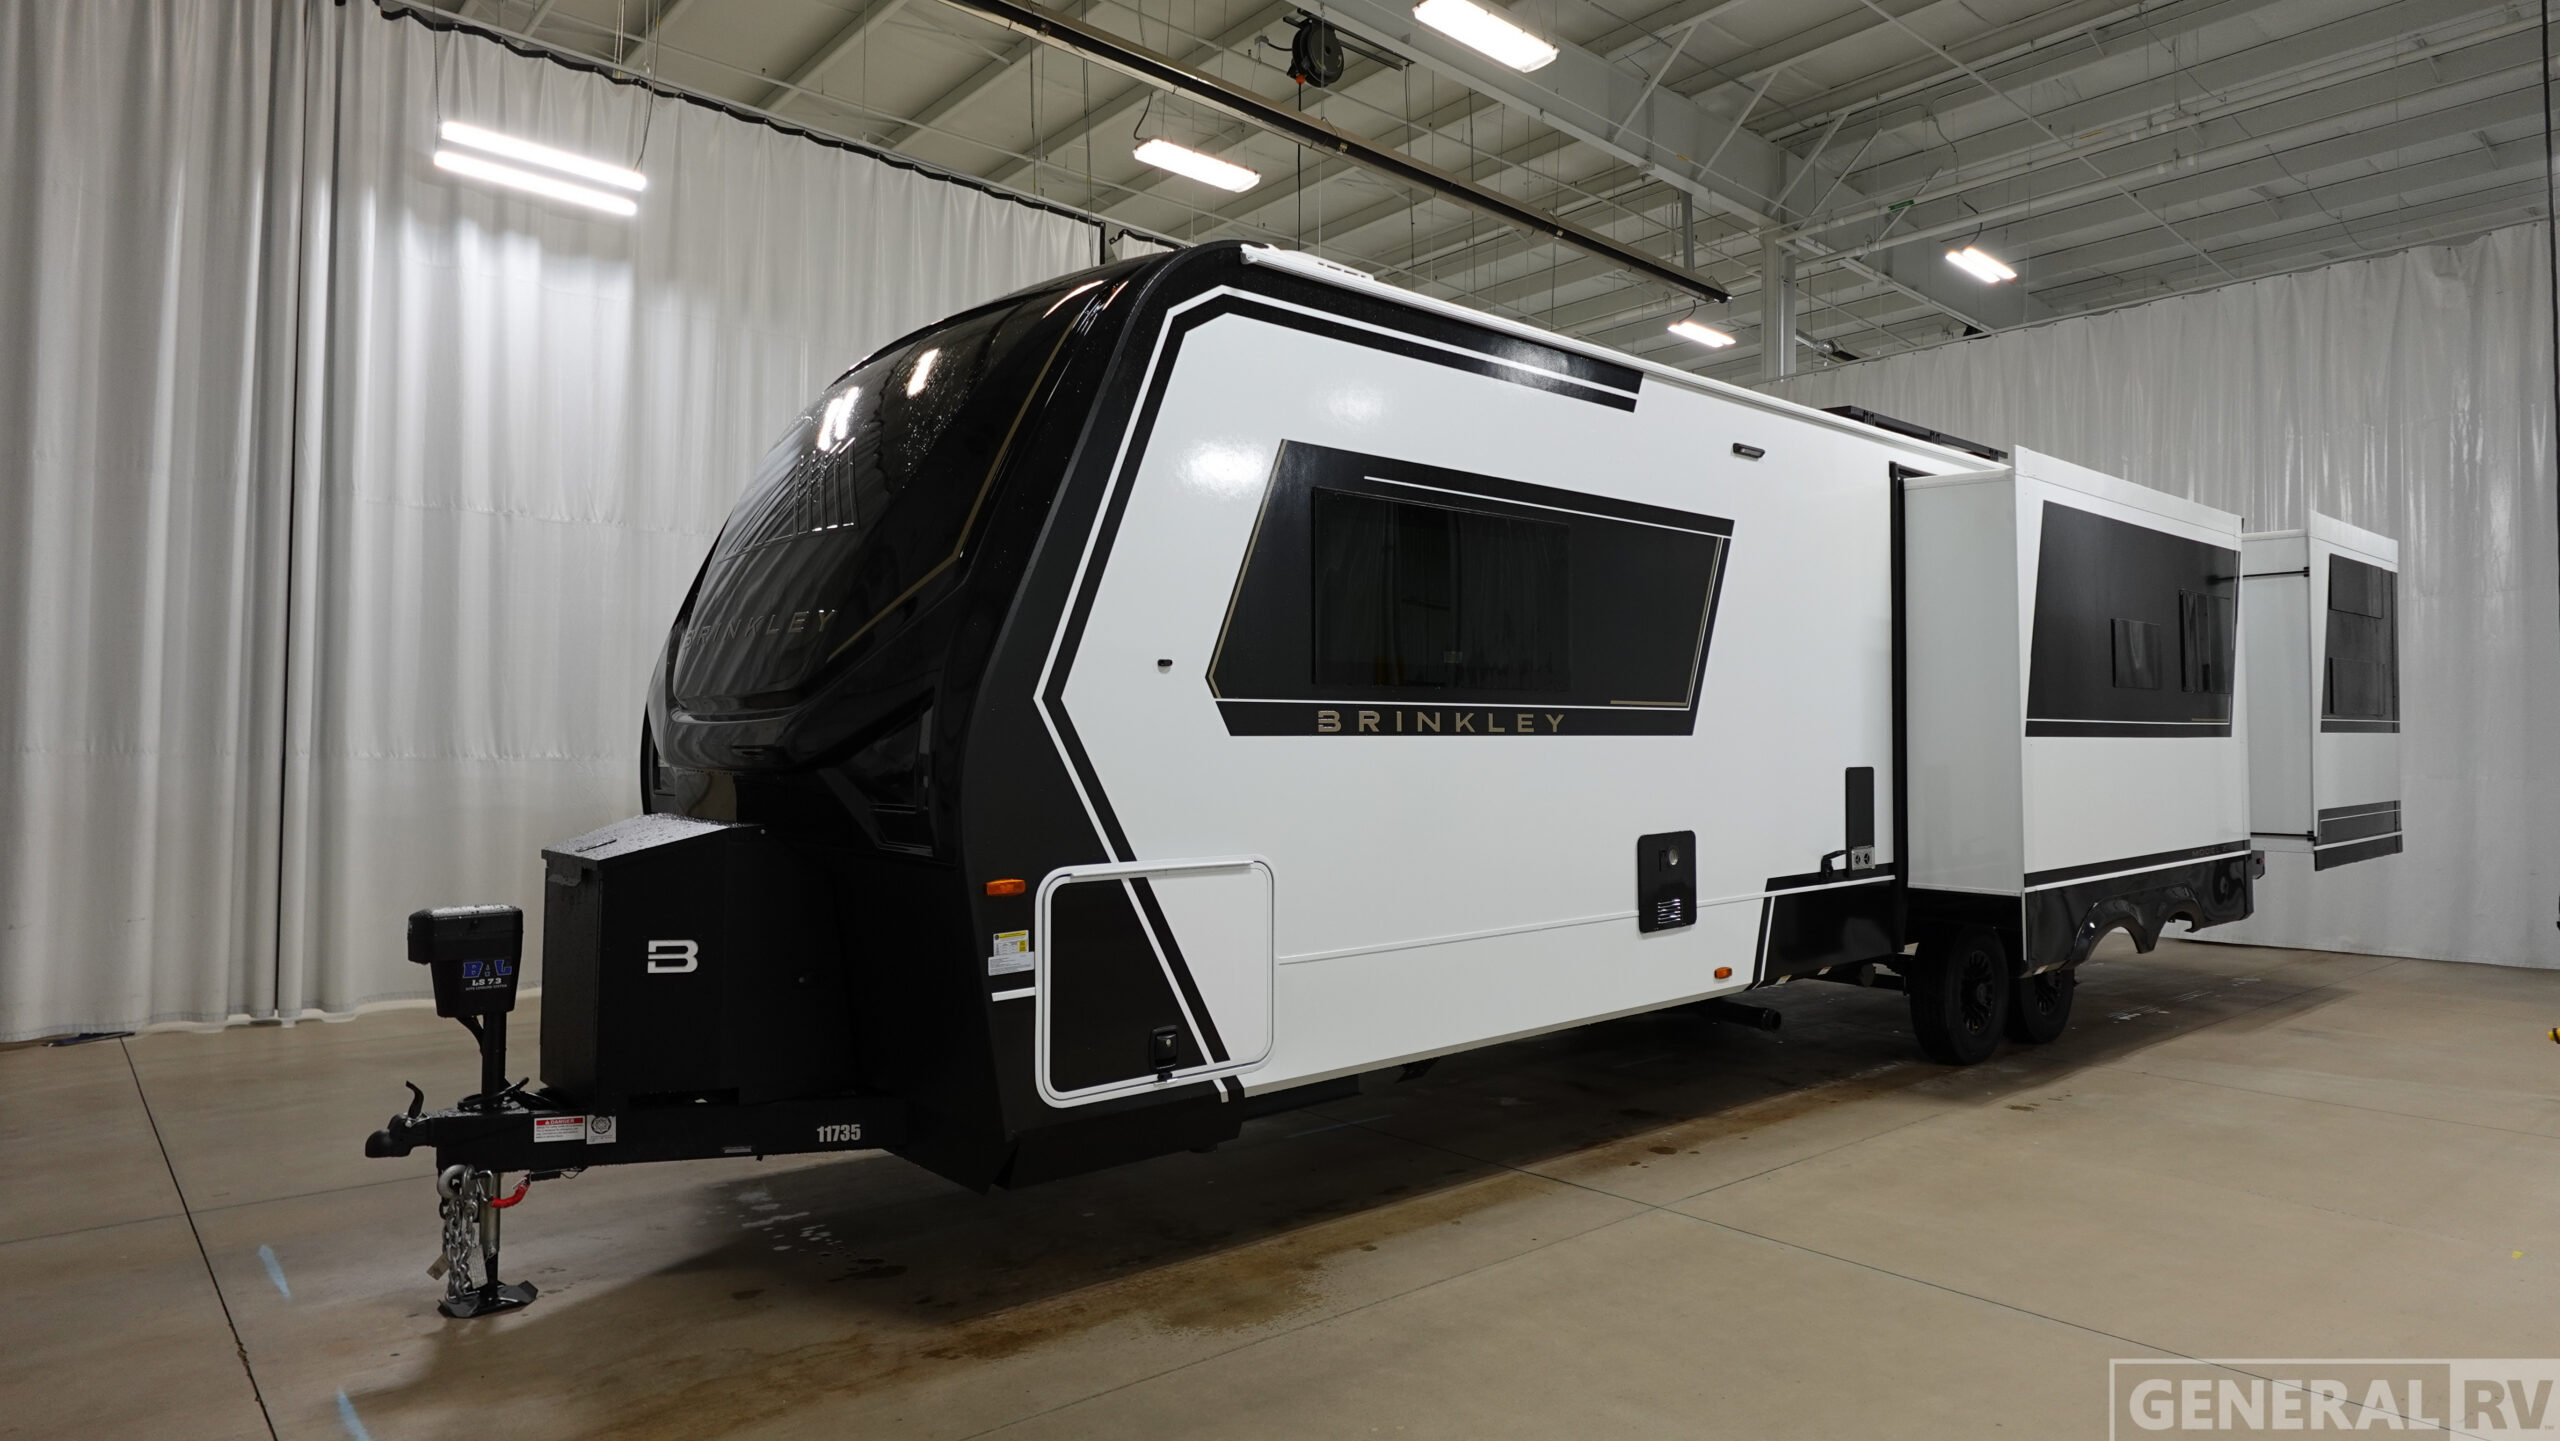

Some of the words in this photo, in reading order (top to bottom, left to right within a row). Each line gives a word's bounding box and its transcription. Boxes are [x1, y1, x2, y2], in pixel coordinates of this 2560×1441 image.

[683, 609, 837, 649] BRINKLEY
[1317, 710, 1565, 733] BRINKLEY
[647, 939, 699, 974] B
[816, 1124, 861, 1143] 11735
